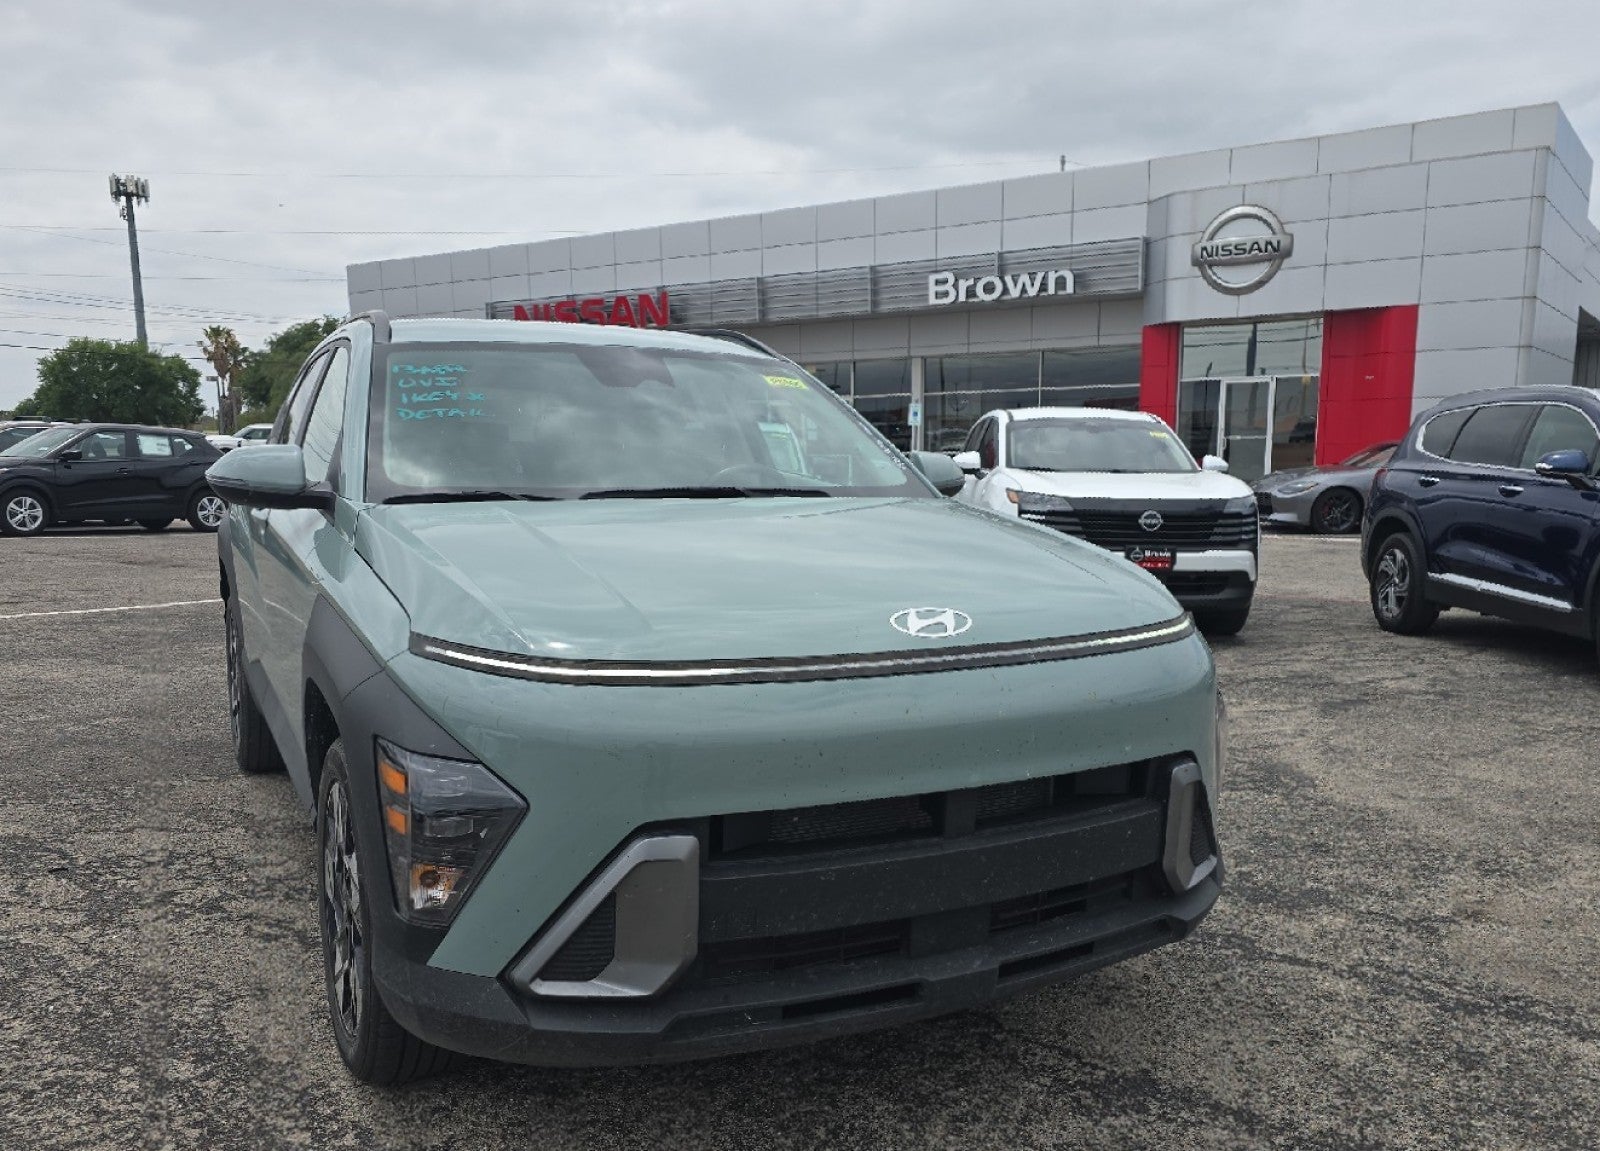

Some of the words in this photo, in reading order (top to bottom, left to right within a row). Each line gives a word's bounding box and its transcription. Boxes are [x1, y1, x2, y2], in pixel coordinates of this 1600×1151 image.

[1200, 239, 1281, 259] NISSAN
[928, 269, 1075, 305] Brown
[513, 290, 670, 329] NISSAN
